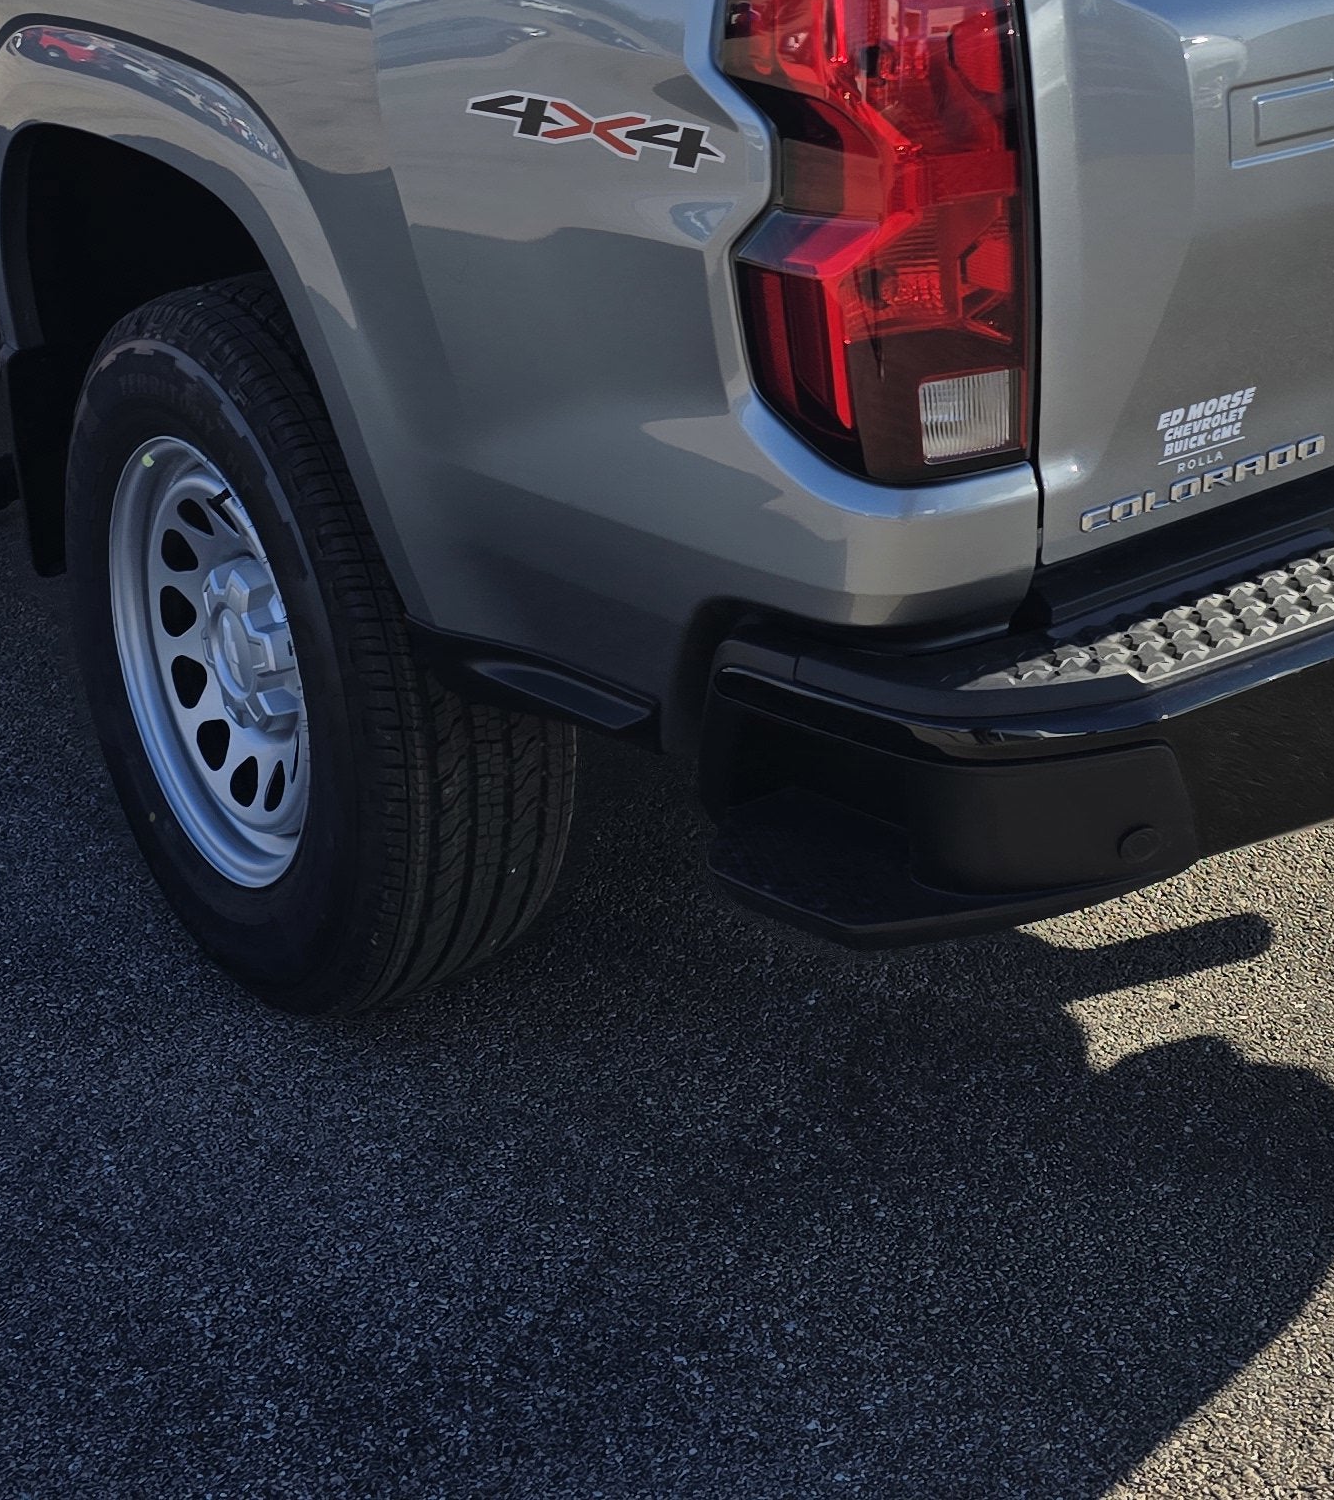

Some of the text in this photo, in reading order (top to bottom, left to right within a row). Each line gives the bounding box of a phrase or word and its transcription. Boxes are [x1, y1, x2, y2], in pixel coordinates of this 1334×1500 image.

[1156, 386, 1257, 431] ED MORSE
[1163, 406, 1248, 442] CHEVROLET
[1176, 450, 1225, 474] ROLLA
[1080, 433, 1326, 533] COLORADO
